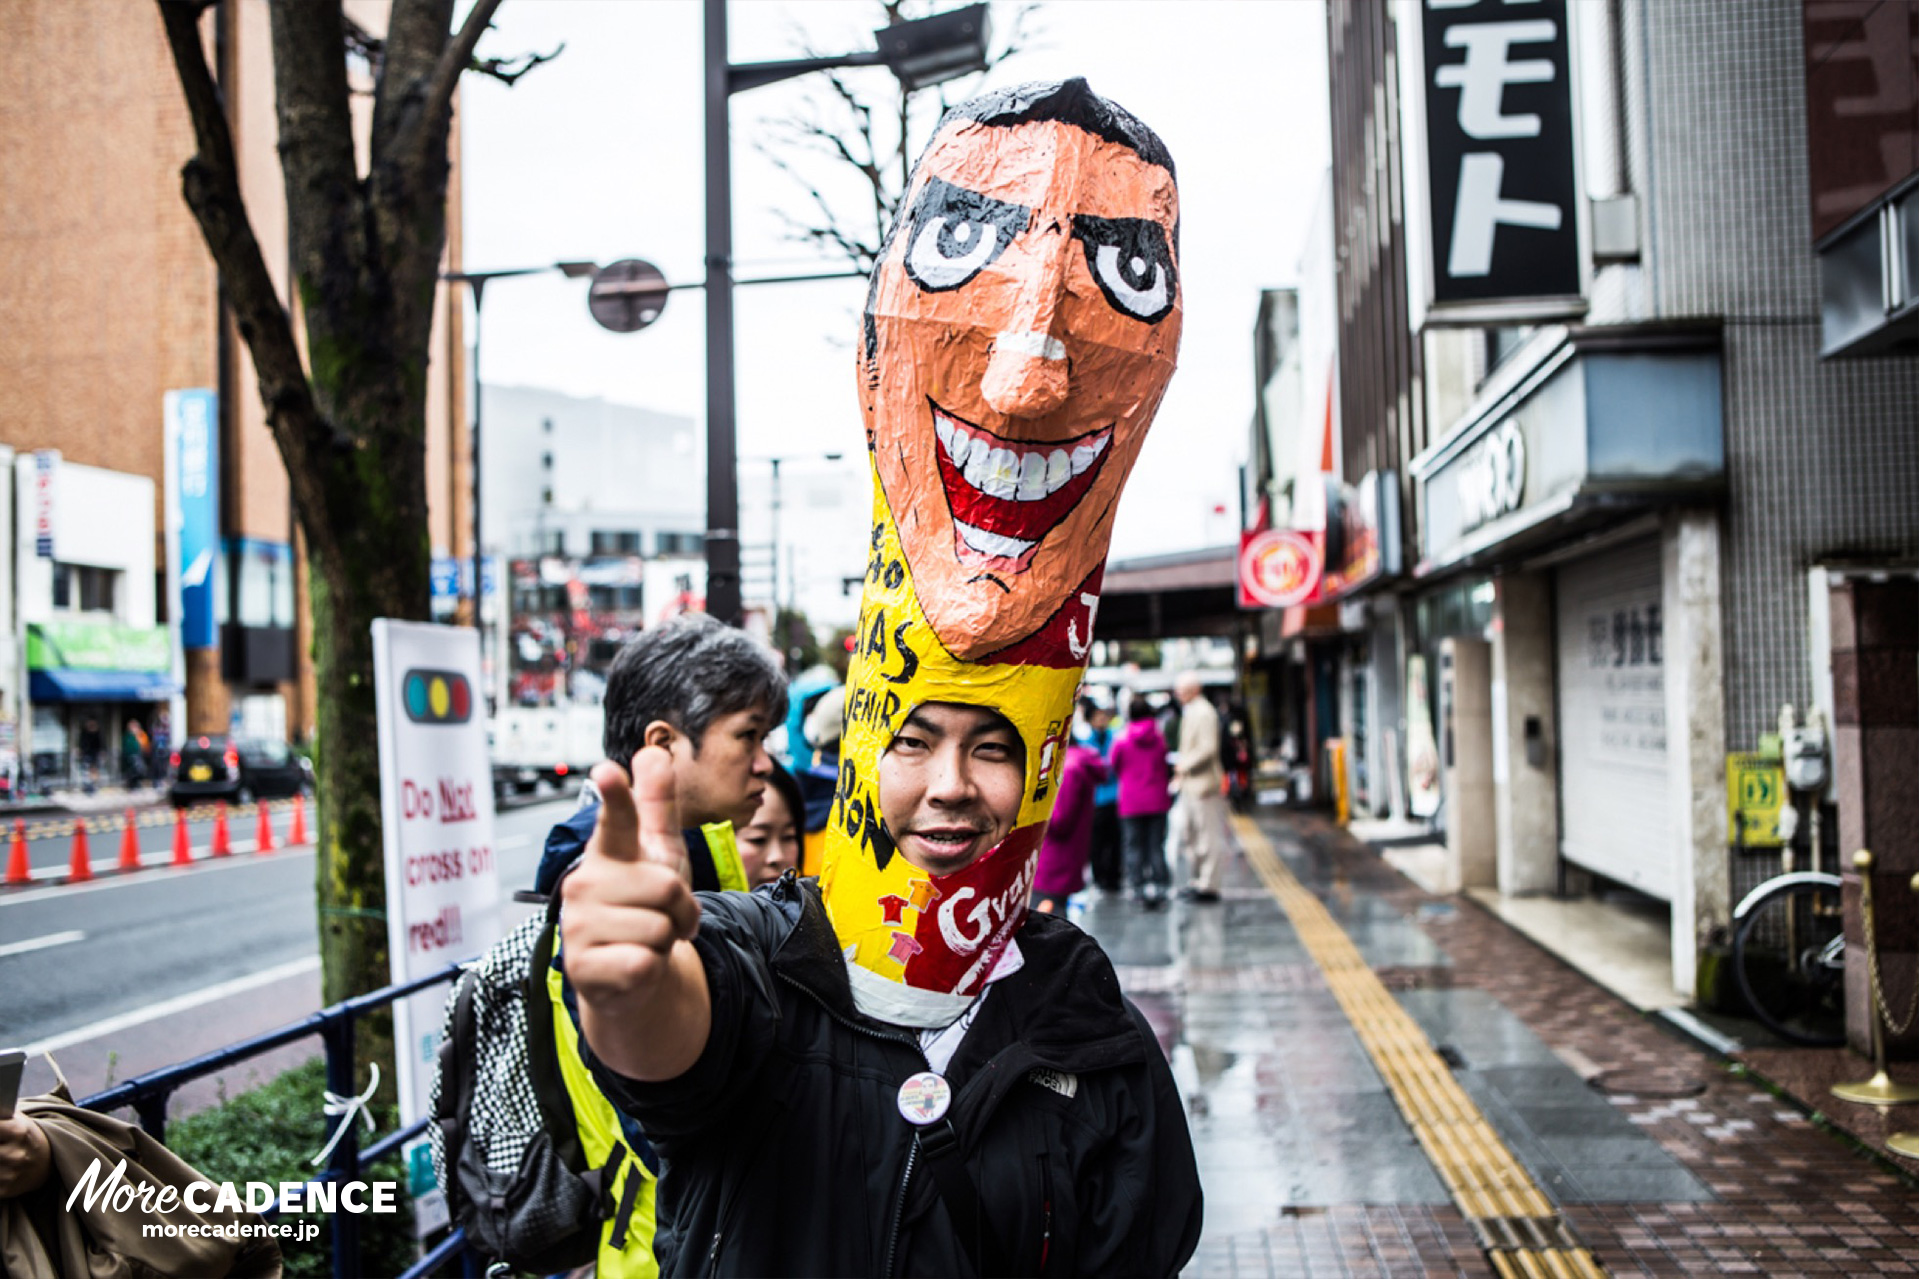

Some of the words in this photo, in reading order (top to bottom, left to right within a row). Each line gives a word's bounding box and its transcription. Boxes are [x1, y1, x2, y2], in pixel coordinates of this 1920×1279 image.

[1429, 0, 1562, 278] モト
[402, 779, 433, 819] Do
[438, 776, 475, 819] Not
[405, 851, 463, 887] cross
[468, 846, 493, 876] on
